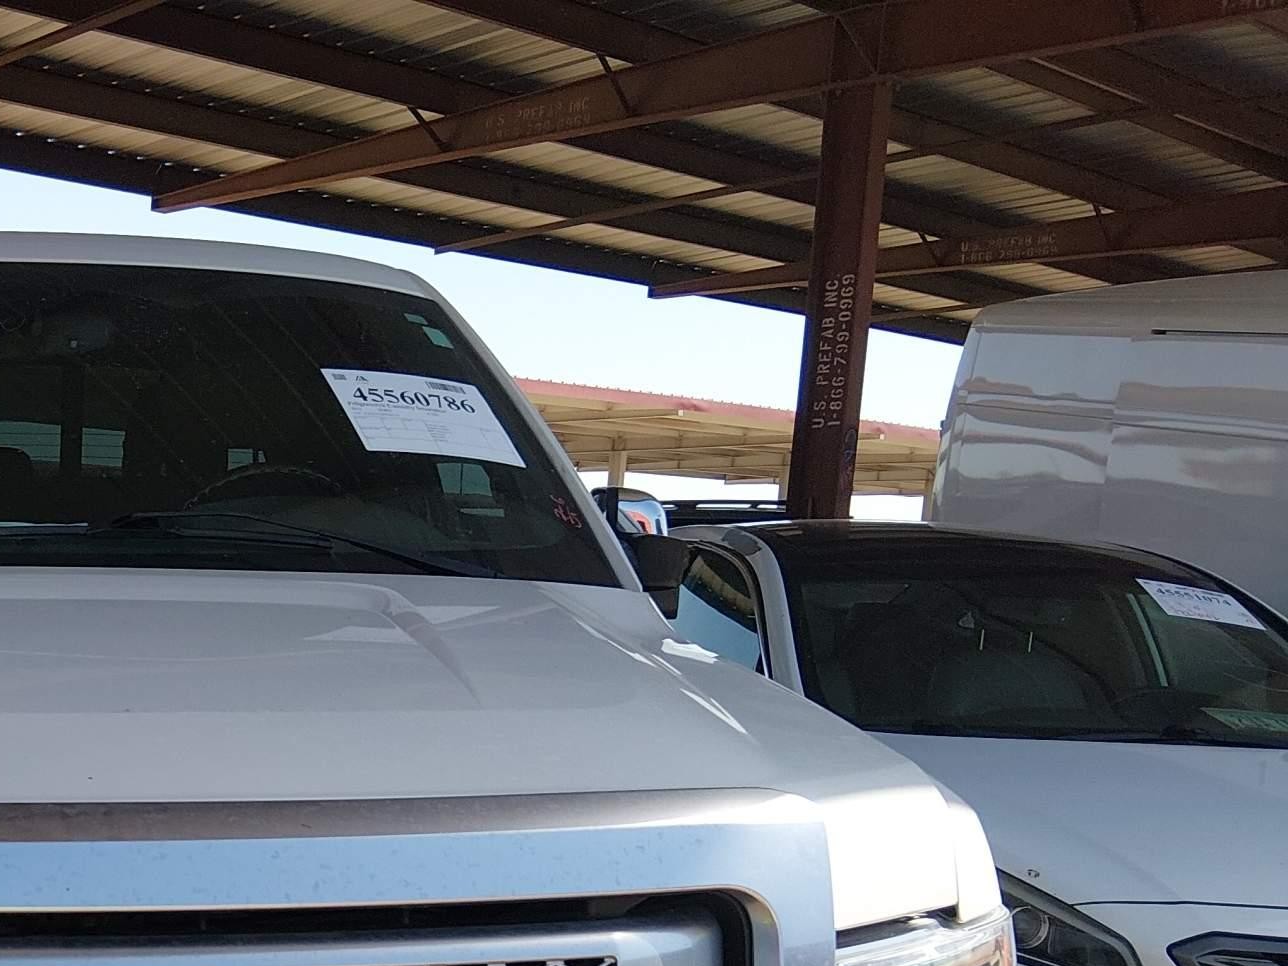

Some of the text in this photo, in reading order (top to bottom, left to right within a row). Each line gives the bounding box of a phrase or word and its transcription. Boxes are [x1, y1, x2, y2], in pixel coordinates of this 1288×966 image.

[816, 317, 835, 385] PREFAB
[827, 273, 856, 426] 1-866-799-0969
[353, 386, 476, 414] 45560786
